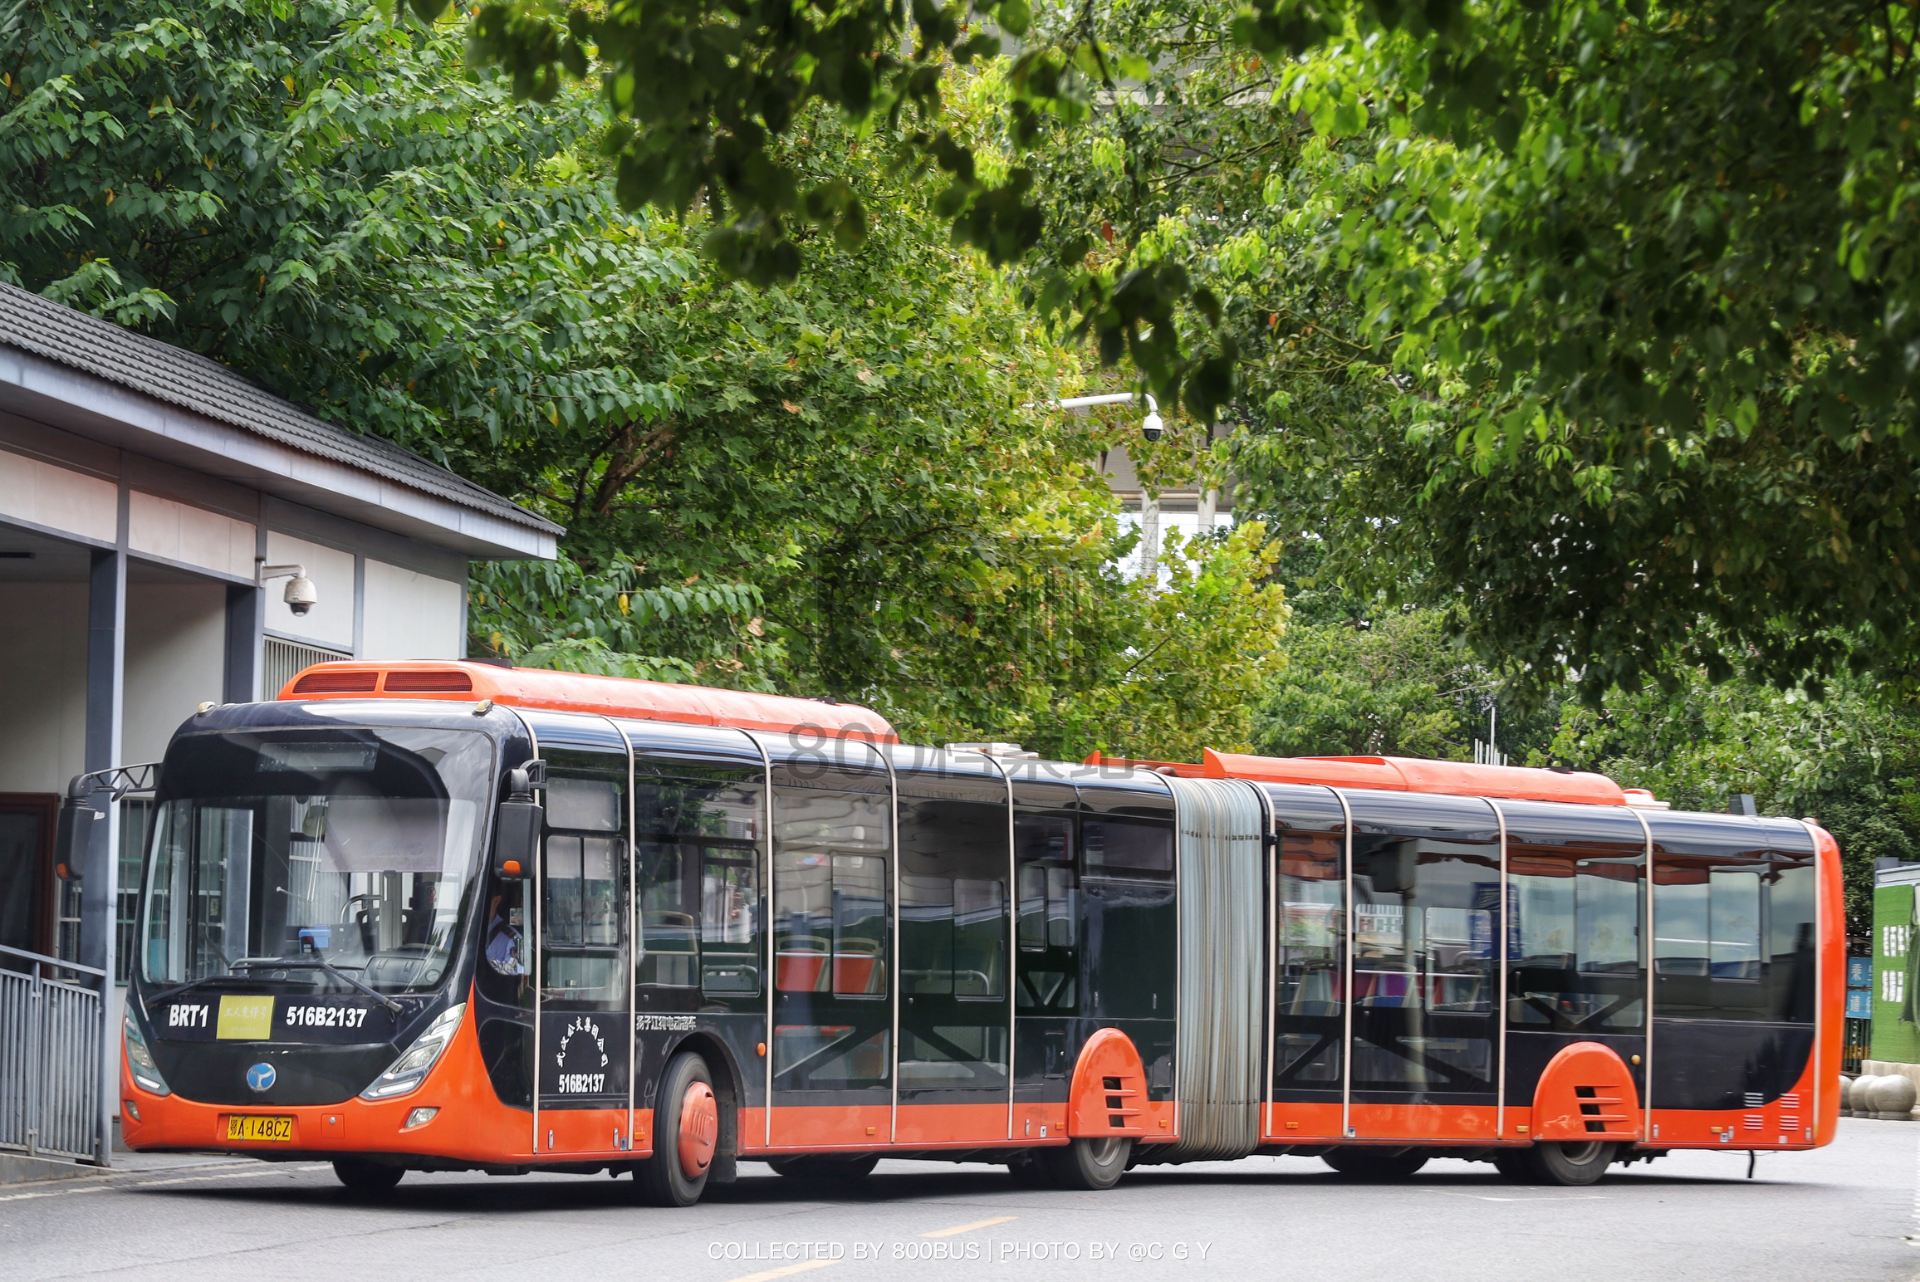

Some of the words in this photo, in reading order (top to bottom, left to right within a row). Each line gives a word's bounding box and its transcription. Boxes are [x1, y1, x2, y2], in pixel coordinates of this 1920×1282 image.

[168, 1004, 209, 1027] BRT1
[223, 1005, 268, 1020] 工人先锋号
[286, 1006, 367, 1027] 516B2137
[558, 1073, 605, 1093] 516B2137
